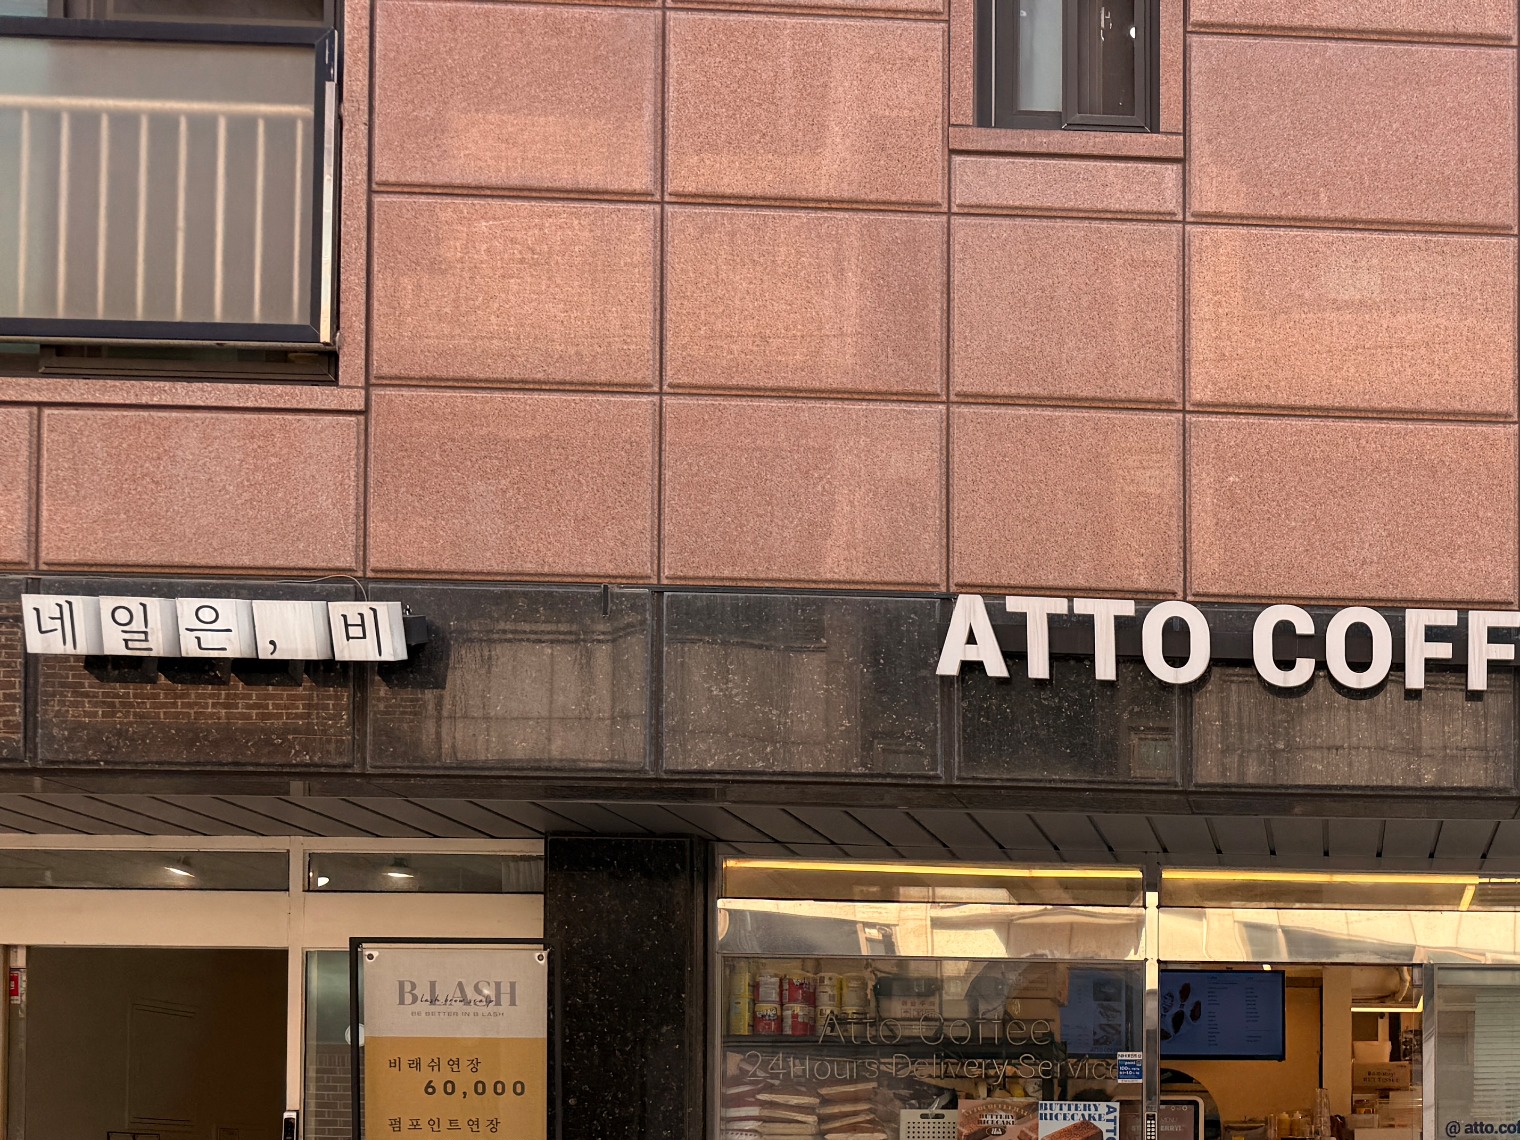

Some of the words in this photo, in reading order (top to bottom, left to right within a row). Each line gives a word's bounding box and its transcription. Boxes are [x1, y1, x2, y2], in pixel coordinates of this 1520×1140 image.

[936, 594, 1210, 684] ATTO
[396, 979, 419, 1006] B
[428, 980, 518, 1006] LASH
[817, 1011, 902, 1045] Atto
[919, 1011, 1050, 1046] Coffee
[388, 1057, 482, 1073] 비래쉬연장
[892, 1051, 1009, 1086] Delivery
[423, 1079, 526, 1099] 60,000
[1039, 1102, 1101, 1112] BUTTERY
[388, 1117, 501, 1133] 펌포인트연장
[1039, 1113, 1106, 1122] RICECAKE
[1445, 1121, 1461, 1138] @
